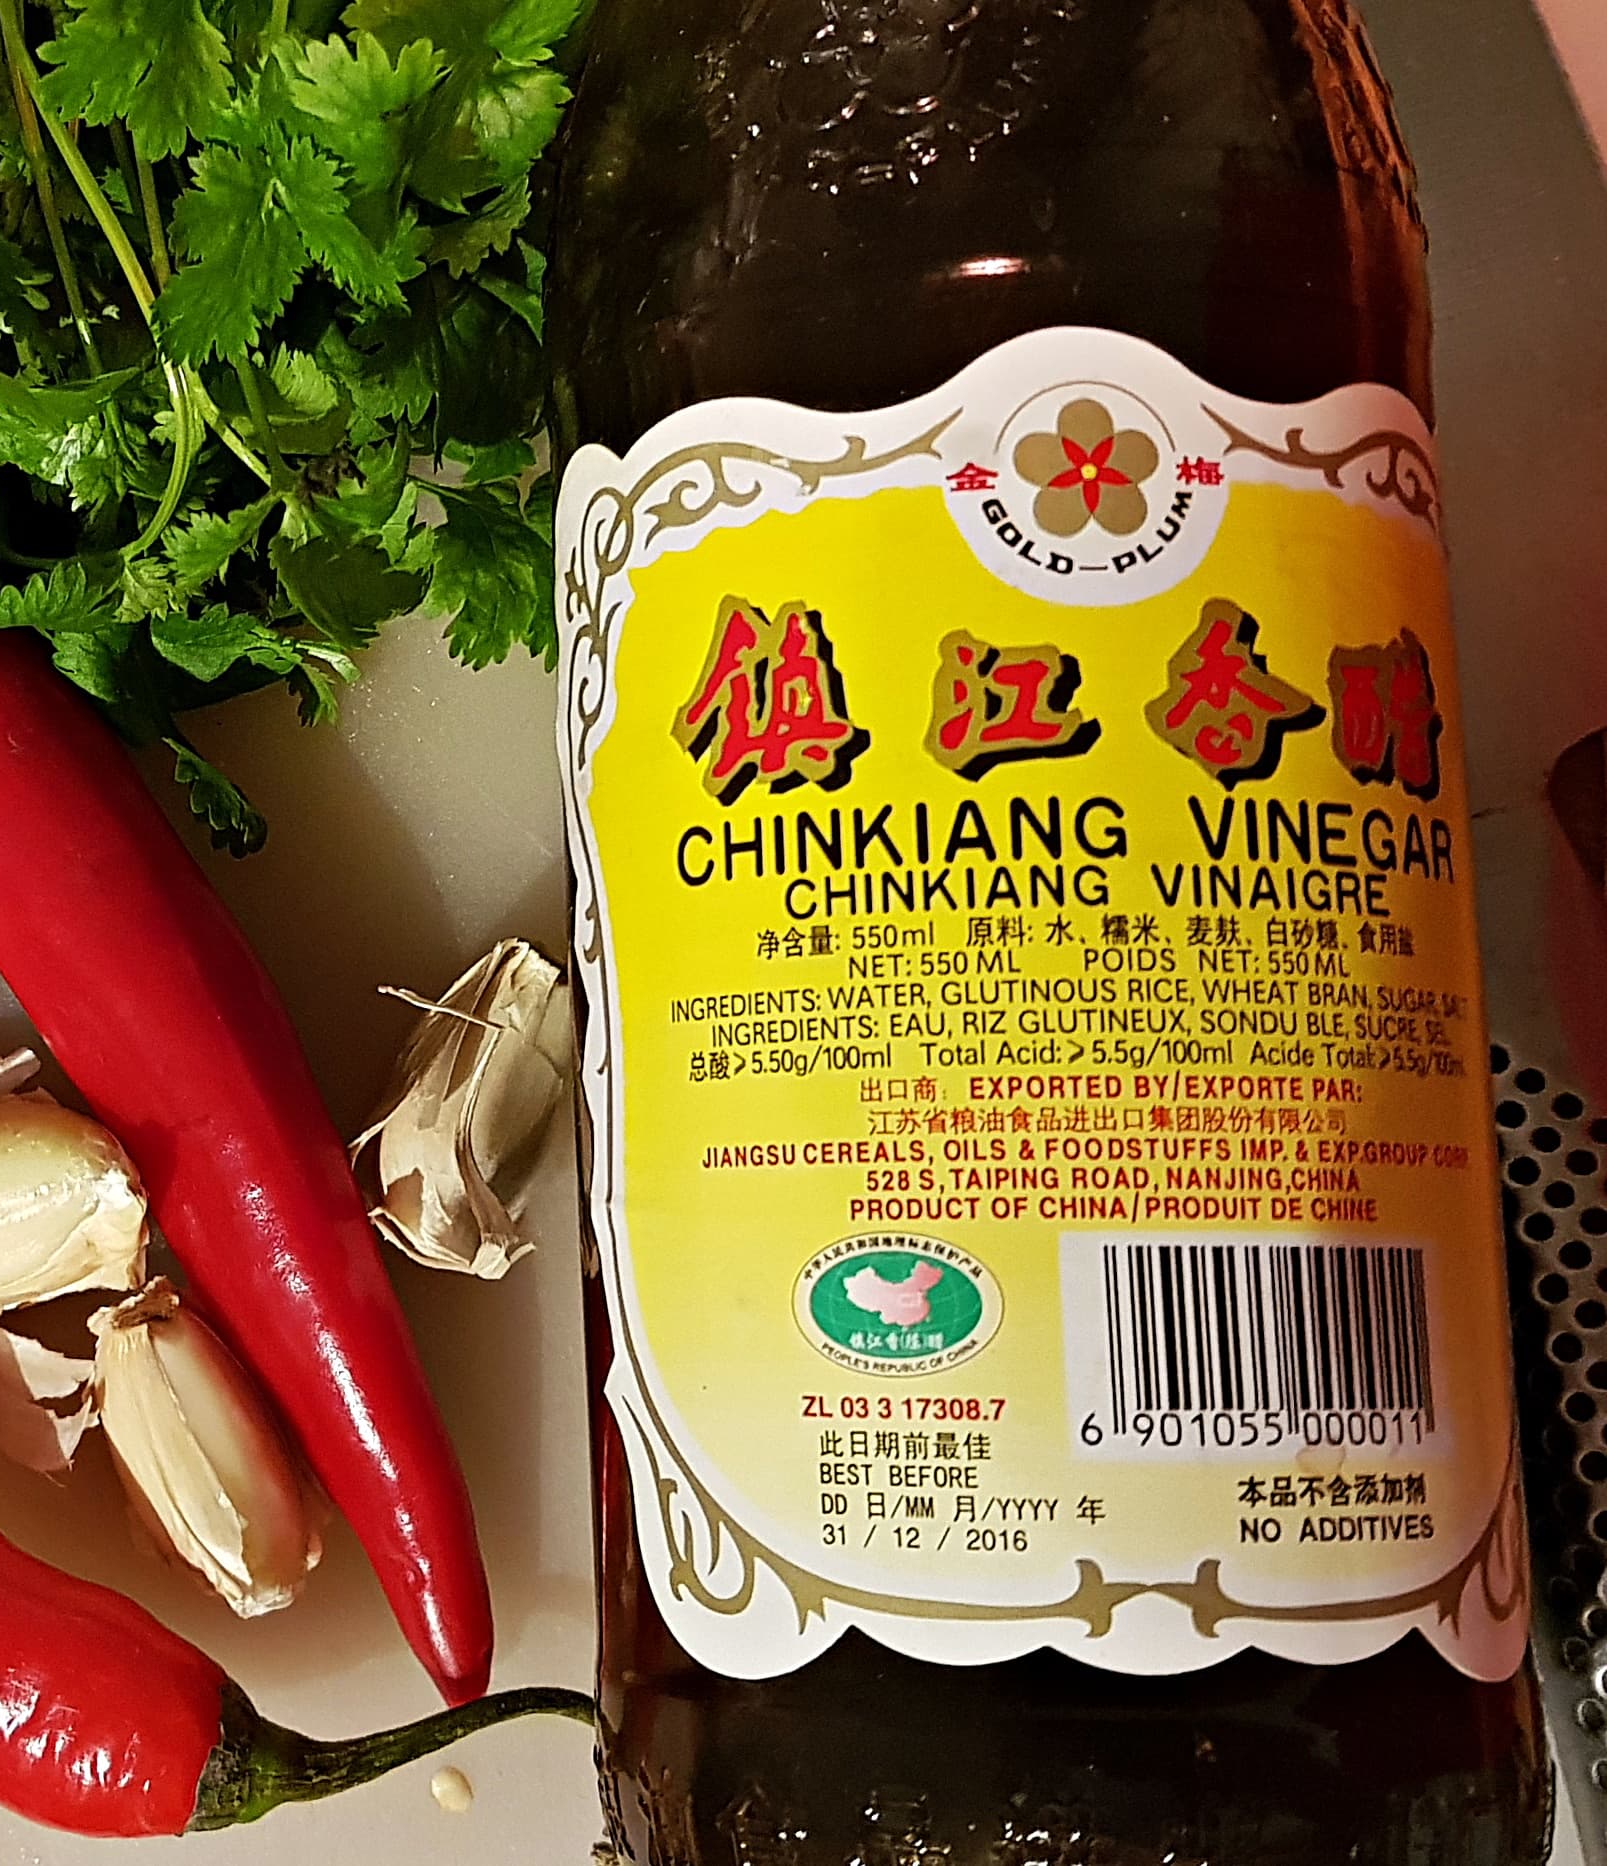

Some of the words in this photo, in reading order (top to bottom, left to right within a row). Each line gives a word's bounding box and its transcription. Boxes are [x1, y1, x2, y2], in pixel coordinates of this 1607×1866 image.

[946, 462, 999, 493] 金
[1175, 455, 1225, 486] 梅
[677, 797, 1128, 890] CHINKIANG
[1187, 797, 1455, 886] VINEGAR
[784, 865, 1109, 922] CHINKIANG
[1151, 863, 1390, 918] VINAIGRE
[851, 921, 934, 950] 550ml
[848, 954, 912, 979] NET:
[920, 952, 968, 975] 550
[977, 951, 1021, 974] ML
[1084, 948, 1177, 973] POIDS
[1199, 950, 1260, 975] NET:
[1267, 951, 1307, 976] 550
[1314, 953, 1351, 979] ML
[671, 988, 822, 1024] INGREDIENTS:
[828, 983, 932, 1011] WATER,
[941, 977, 1116, 1008] GLUTINOUS
[1127, 978, 1196, 1004] RICE,
[1203, 979, 1299, 1006] WHEAT
[1308, 982, 1373, 1010] BRAN,
[712, 1016, 881, 1047] INGREDIENTS:
[891, 1013, 953, 1041] EAU,
[963, 1011, 1006, 1034] RIZ
[1018, 1008, 1192, 1036] GLUTINEUX,
[1307, 1011, 1350, 1039] BLE,
[920, 1043, 987, 1066] Total
[1250, 1041, 1314, 1067] Acide
[970, 1075, 1121, 1100] EXPORTED
[1134, 1071, 1303, 1102] BY/EXPORTE
[1313, 1078, 1362, 1103] PAR:
[867, 1106, 1347, 1136] 江苏省粮油食品进出口集团股份有限公司
[702, 1145, 795, 1169] JIANGSU
[804, 1140, 935, 1167] CEREALS,
[943, 1139, 1005, 1161] OILS
[1019, 1140, 1035, 1160] &
[1044, 1138, 1231, 1162] FOODSTUFFS
[1241, 1139, 1288, 1162] IMP.
[1294, 1140, 1309, 1162] &
[867, 1171, 909, 1192] 528
[1072, 1168, 1160, 1193] ROAD,
[850, 1197, 980, 1221] PRODUCT
[992, 1197, 1028, 1220] OF
[1039, 1192, 1261, 1225] CHINA/PRODUIT
[1271, 1198, 1302, 1220] DE
[1311, 1197, 1378, 1222] CHINE
[821, 1342, 869, 1370] PEOPLE'S
[873, 1361, 927, 1373] REPUBLIC
[929, 1357, 943, 1369] OF
[946, 1339, 978, 1362] CHINA
[801, 1397, 836, 1419] ZL
[840, 1397, 872, 1419] 03
[877, 1397, 894, 1419] 3
[900, 1398, 1006, 1421] 17308.7
[1079, 1414, 1104, 1448] 6
[1134, 1412, 1283, 1448] 901055
[1303, 1411, 1425, 1447] 000011
[819, 1431, 992, 1462] 此日期前最佳
[819, 1465, 873, 1488] BEST
[889, 1466, 979, 1489] BEFORE
[821, 1494, 848, 1516] DD
[1076, 1496, 1106, 1523] 年
[823, 1525, 847, 1548] 31
[894, 1526, 922, 1549] 12
[966, 1529, 1029, 1553] 2016
[1239, 1518, 1281, 1544] NO
[1298, 1513, 1435, 1542] ADDITIVES
